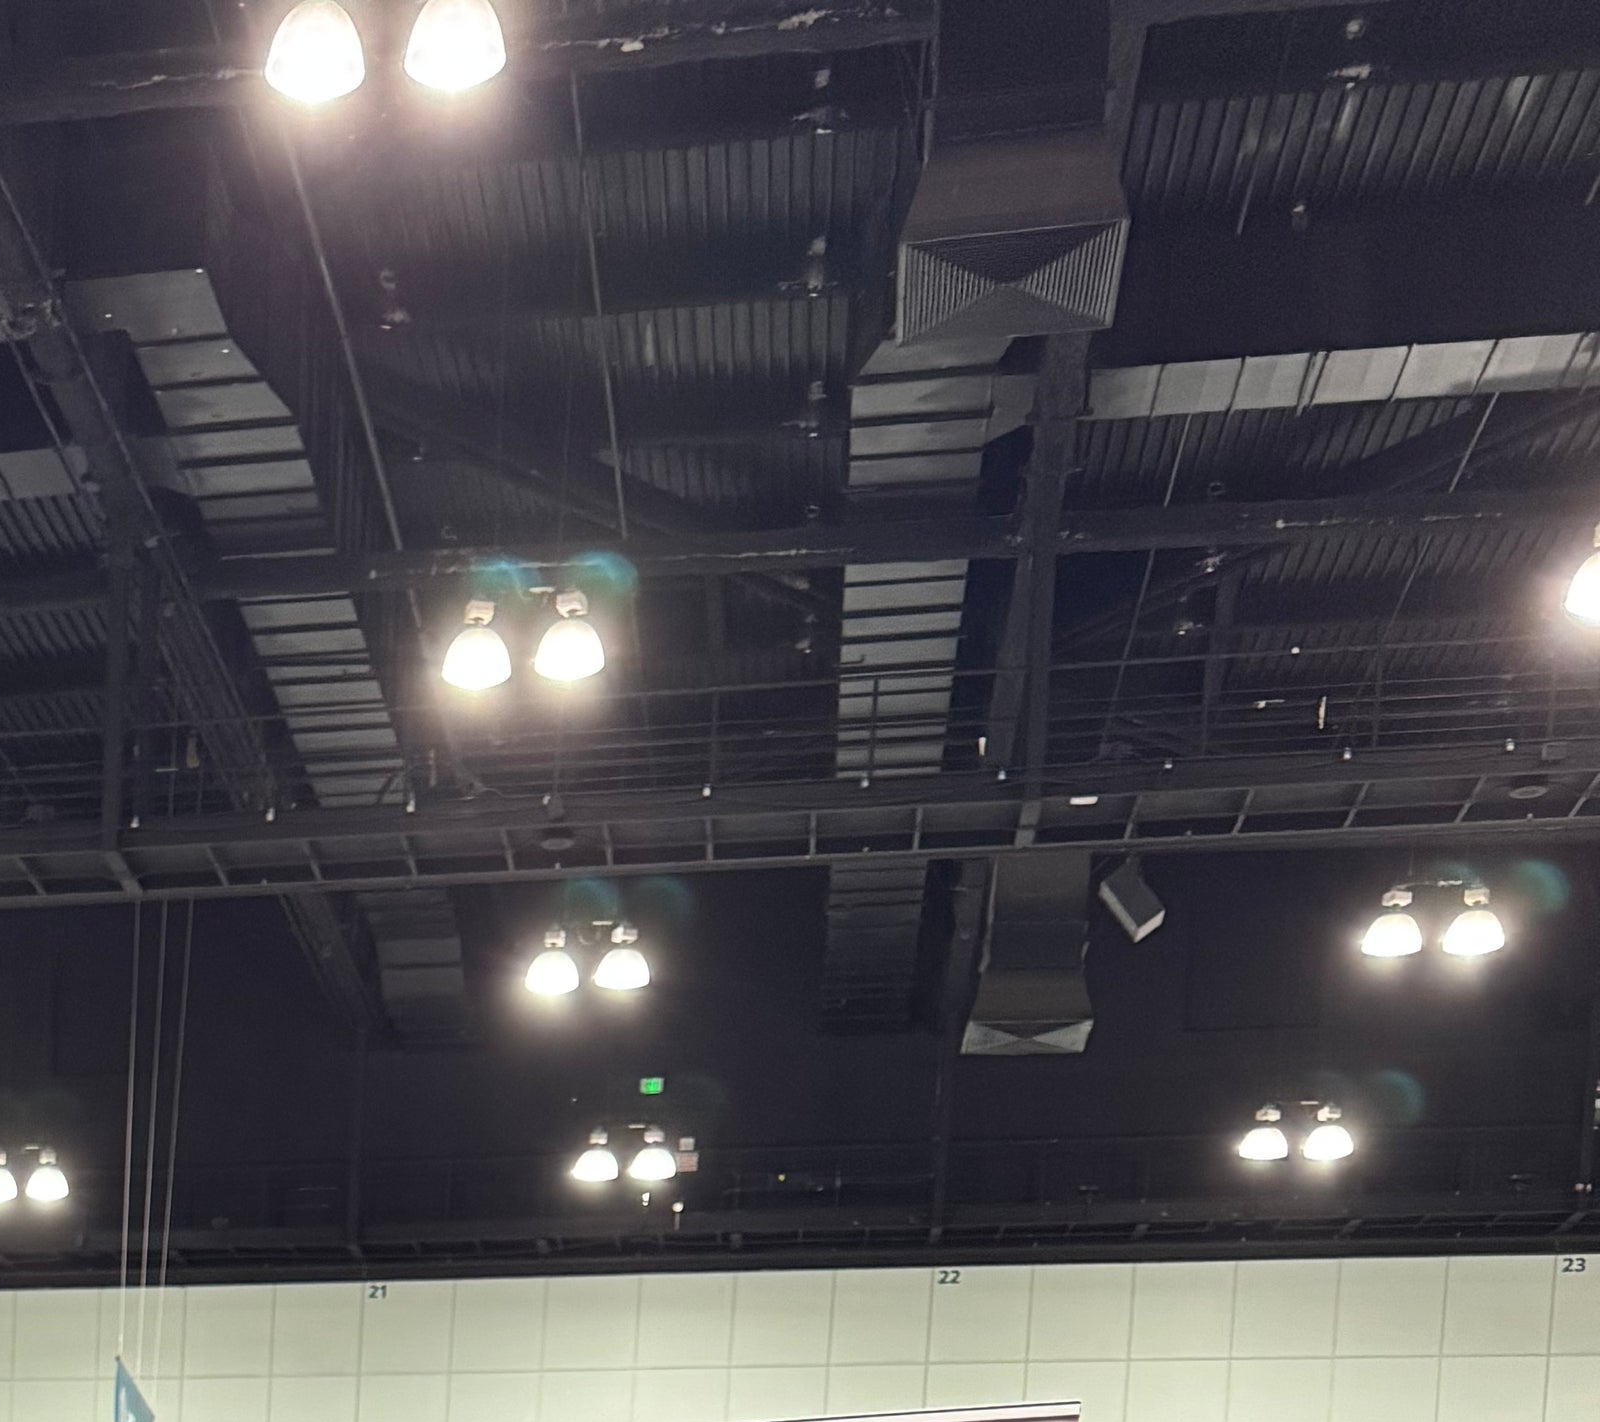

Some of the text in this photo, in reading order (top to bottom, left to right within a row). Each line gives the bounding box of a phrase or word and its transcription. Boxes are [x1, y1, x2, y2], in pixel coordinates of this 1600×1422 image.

[1561, 1257, 1587, 1272] 23
[937, 1270, 961, 1284] 22
[368, 1285, 388, 1299] 21
